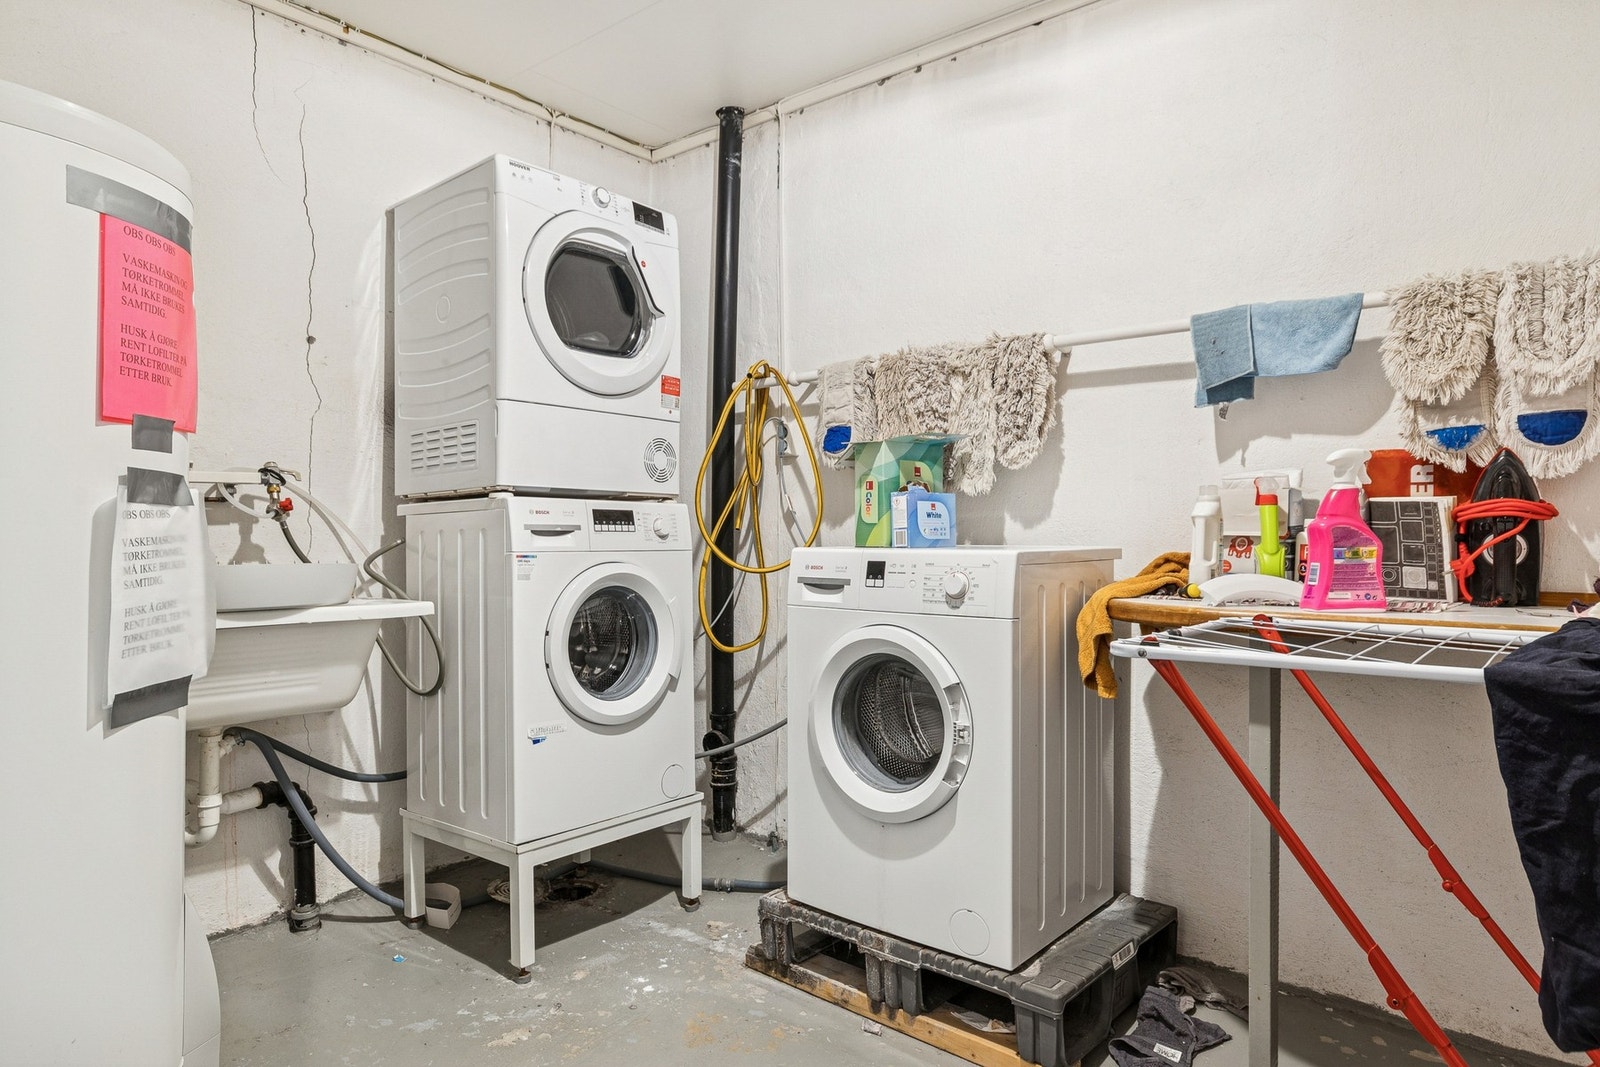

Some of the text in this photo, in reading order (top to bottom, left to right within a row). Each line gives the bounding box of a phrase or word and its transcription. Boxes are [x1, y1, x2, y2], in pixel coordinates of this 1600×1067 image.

[123, 225, 176, 257] OBS OBS OBS
[122, 252, 188, 290] VASKEMASKIN OG
[122, 266, 185, 302] TØRKETROMMEL
[121, 295, 167, 319] SAMTIDIG.
[122, 280, 185, 314] MÅ IKKE BRUKES
[120, 323, 178, 350] HUSK Å GJØRE
[120, 338, 188, 367] RENT LOFILTER PÅ
[120, 352, 183, 378] TØRKETROMMEL
[120, 366, 172, 388] ETTER BRUK.
[122, 509, 171, 520] OBS OBS OBS
[926, 511, 942, 519] White
[123, 563, 138, 575] MÅ
[140, 562, 158, 574] IKKE
[124, 604, 147, 618] HUSK
[124, 618, 146, 632] RENT
[121, 644, 148, 659] ETTER
